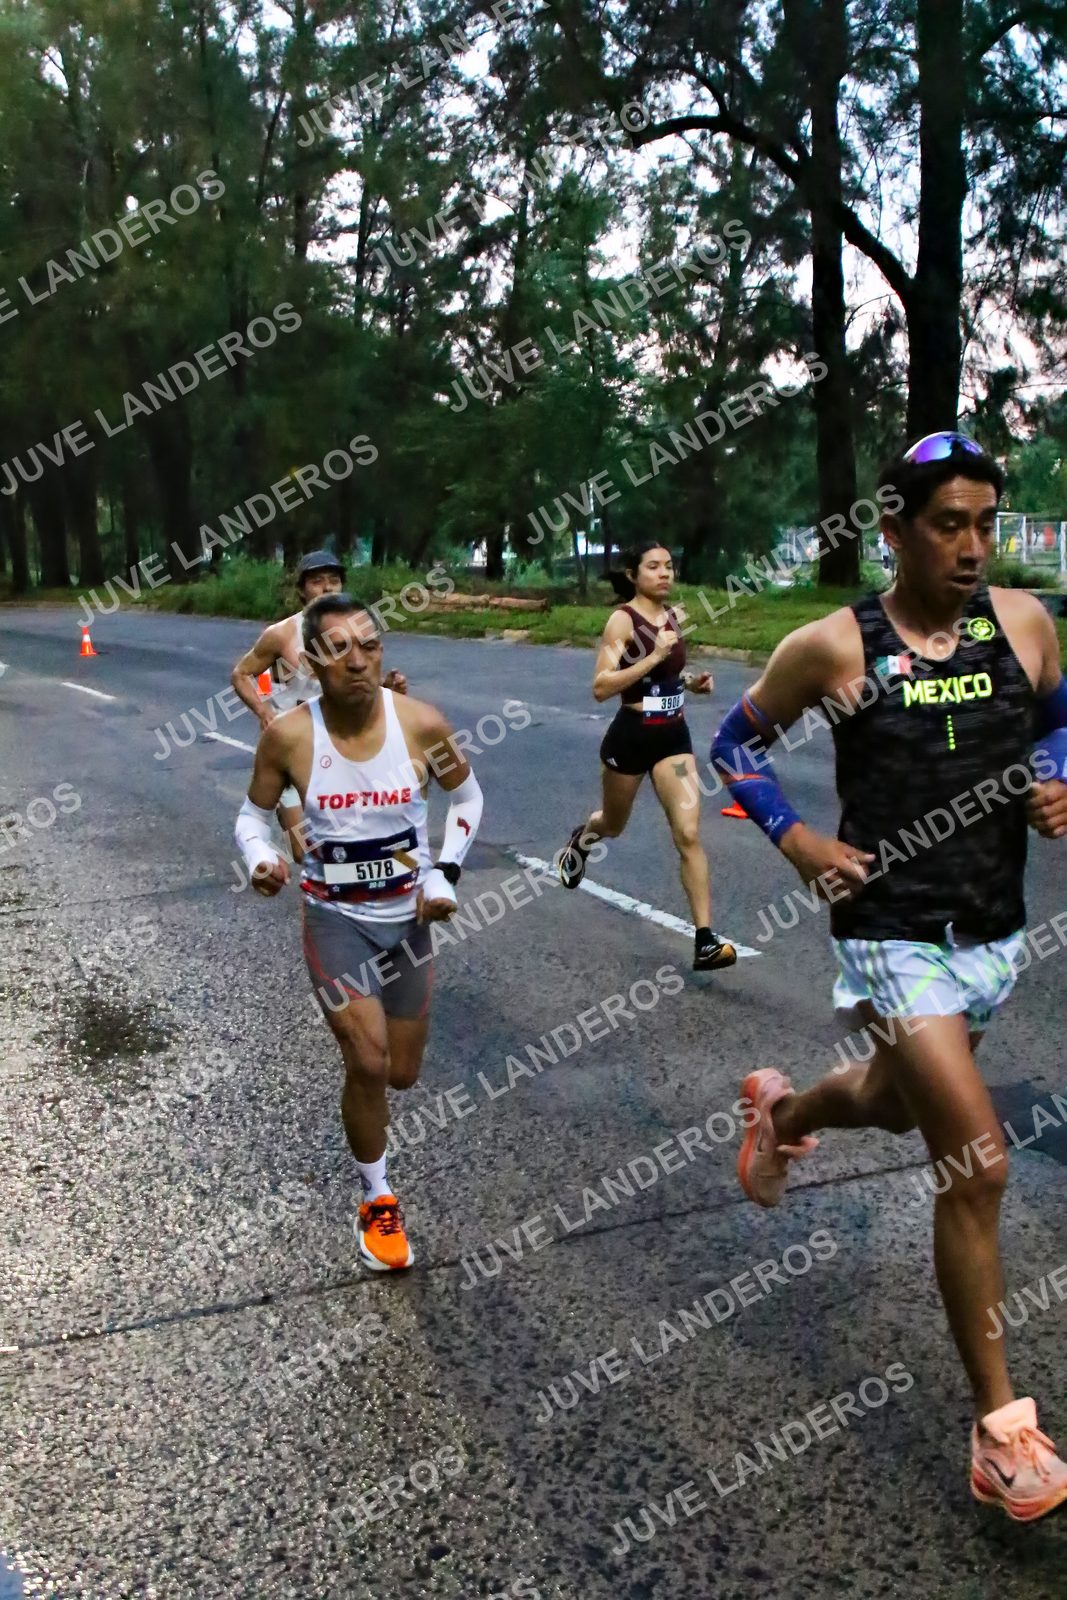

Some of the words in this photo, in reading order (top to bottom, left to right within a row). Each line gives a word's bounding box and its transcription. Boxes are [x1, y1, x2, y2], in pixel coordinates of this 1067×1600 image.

[903, 673, 992, 707] MEXICO
[317, 787, 411, 810] TOPTIME
[356, 860, 394, 880] 5178
